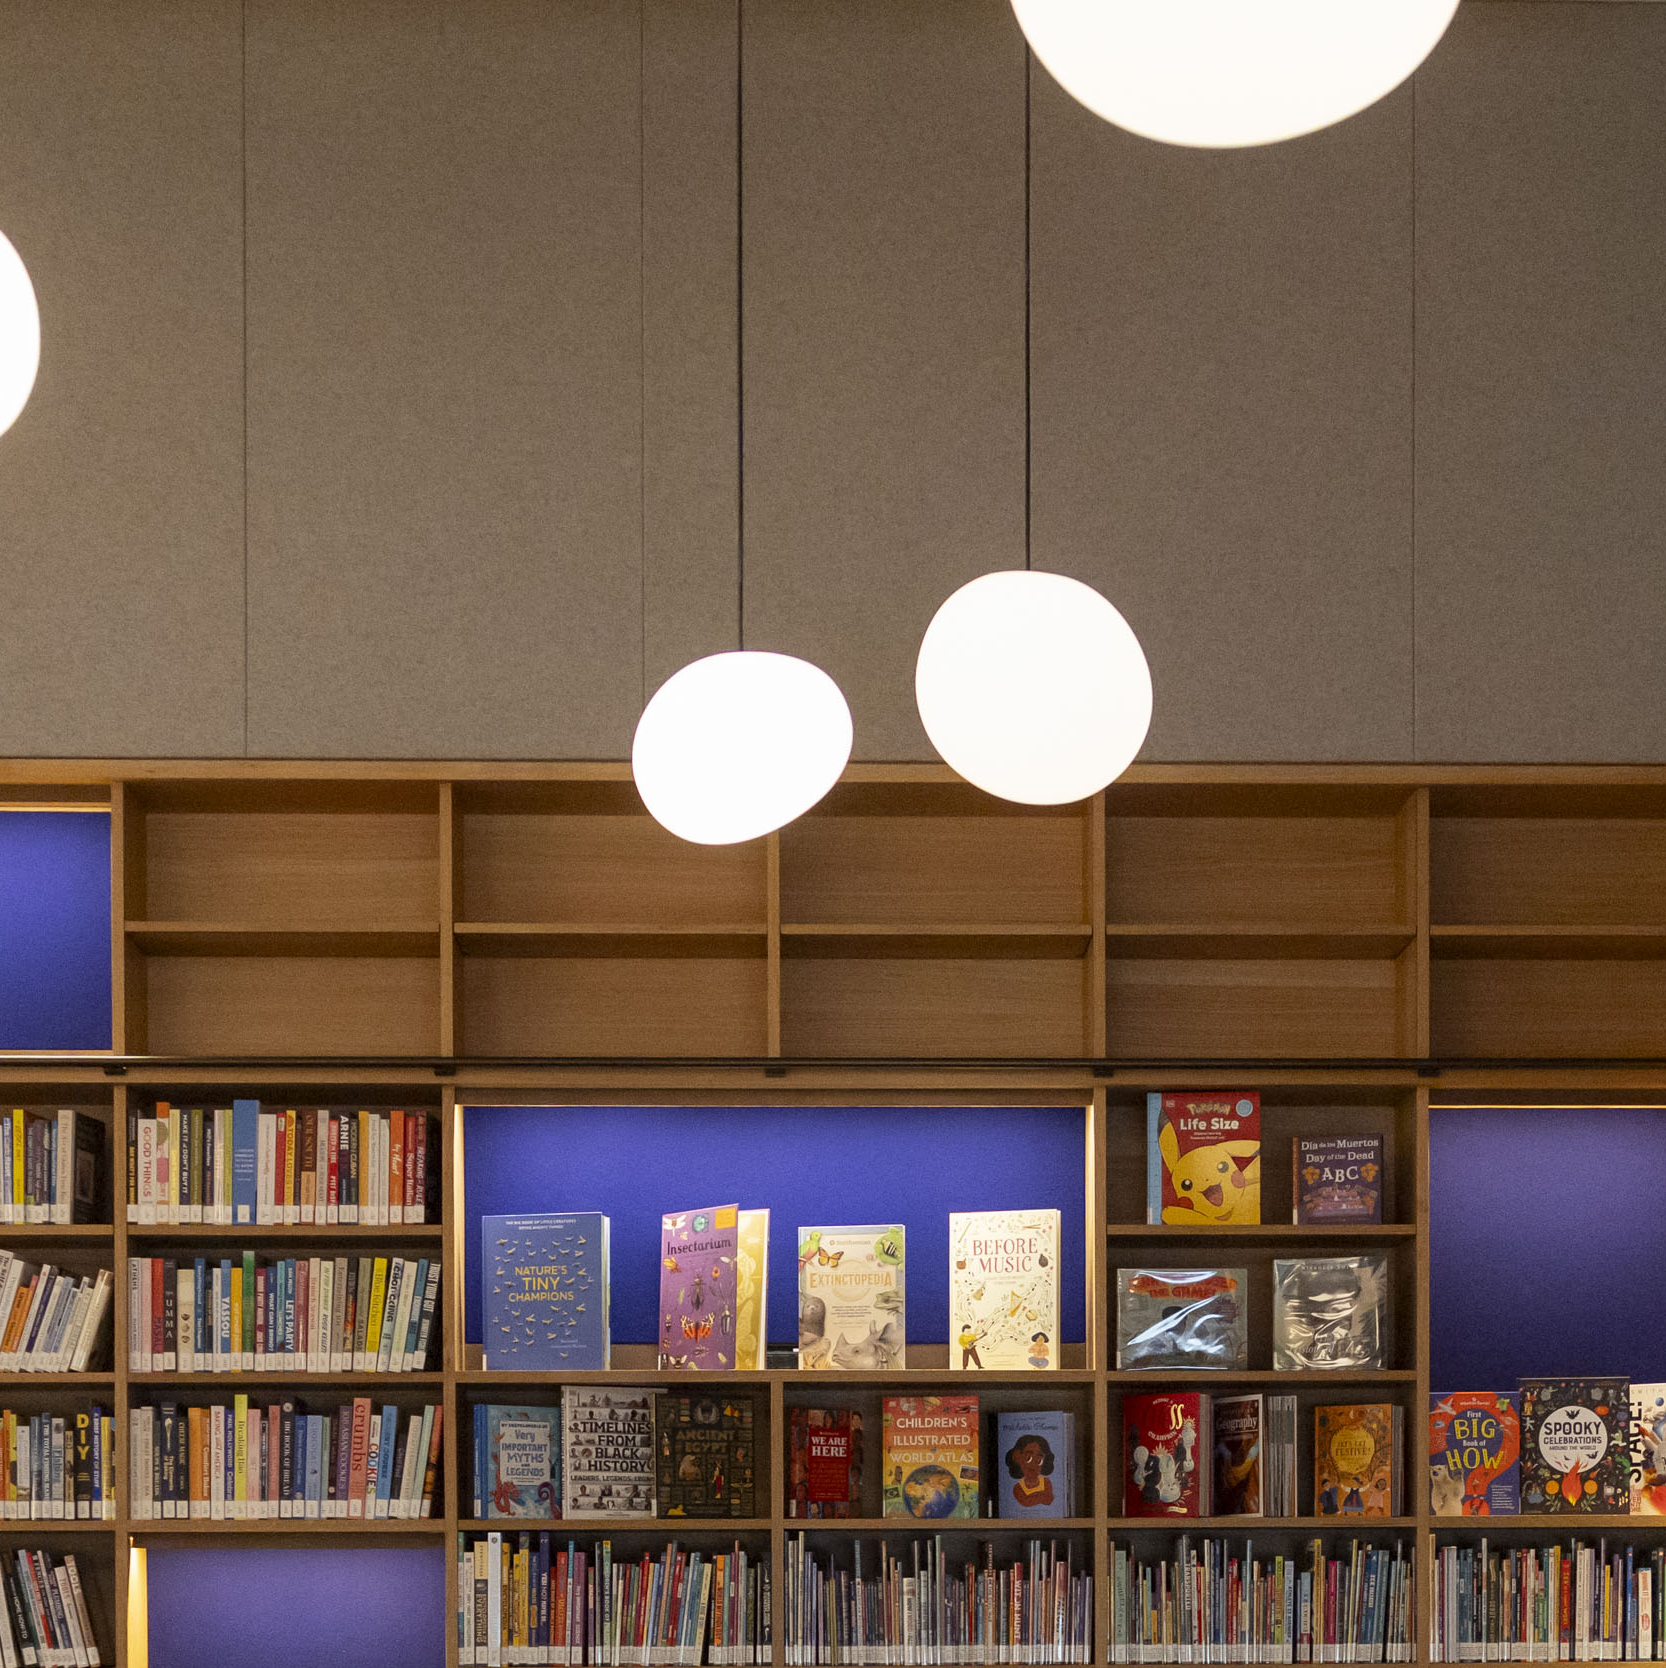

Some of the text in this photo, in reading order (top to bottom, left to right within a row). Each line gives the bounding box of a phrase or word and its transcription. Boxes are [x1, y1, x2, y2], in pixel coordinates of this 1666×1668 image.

[1180, 1118, 1240, 1131] Life Size
[340, 1116, 349, 1150] ARNIE
[1337, 1139, 1379, 1149] Muertos
[143, 1127, 152, 1197] GOOD THINGS
[1305, 1152, 1325, 1164] Day
[1348, 1151, 1374, 1161] Dead
[1321, 1166, 1360, 1183] ABC
[667, 1239, 732, 1255] Insectarium
[973, 1238, 1038, 1256] BEFORE
[515, 1265, 568, 1276] NATURE'S
[979, 1256, 1032, 1273] MUSIC
[522, 1277, 560, 1290] TINY
[810, 1272, 893, 1289] EXTINCTOPEDIA
[508, 1291, 574, 1302] CHAMPIONS
[221, 1297, 230, 1338] YASSOU
[285, 1300, 295, 1350] LET'S PARTY
[1467, 1410, 1482, 1418] First
[580, 1421, 651, 1434] TIMELINES
[896, 1418, 967, 1429] CHILDREN'S
[1215, 1417, 1257, 1430] Geography
[1454, 1418, 1496, 1440] BIG
[1543, 1422, 1601, 1435] SPOOKY
[351, 1405, 368, 1471] crumbs
[597, 1435, 636, 1447] FROM
[811, 1437, 847, 1446] WE ARE
[893, 1435, 971, 1446] ILLUSTRATED
[1543, 1437, 1602, 1445] CELEBRATIONS
[502, 1443, 547, 1451] IMPORTANT
[595, 1447, 639, 1459] BLACK
[811, 1446, 847, 1457] HERE
[283, 1456, 290, 1467] OF
[507, 1453, 544, 1463] MYTHS
[890, 1452, 974, 1464] WORLD ATLAS
[1444, 1448, 1505, 1471] HOW
[367, 1443, 379, 1495] COOKIES
[506, 1467, 545, 1477] LEGENDS
[587, 1460, 647, 1472] HISTORY
[282, 1469, 290, 1495] BREAD
